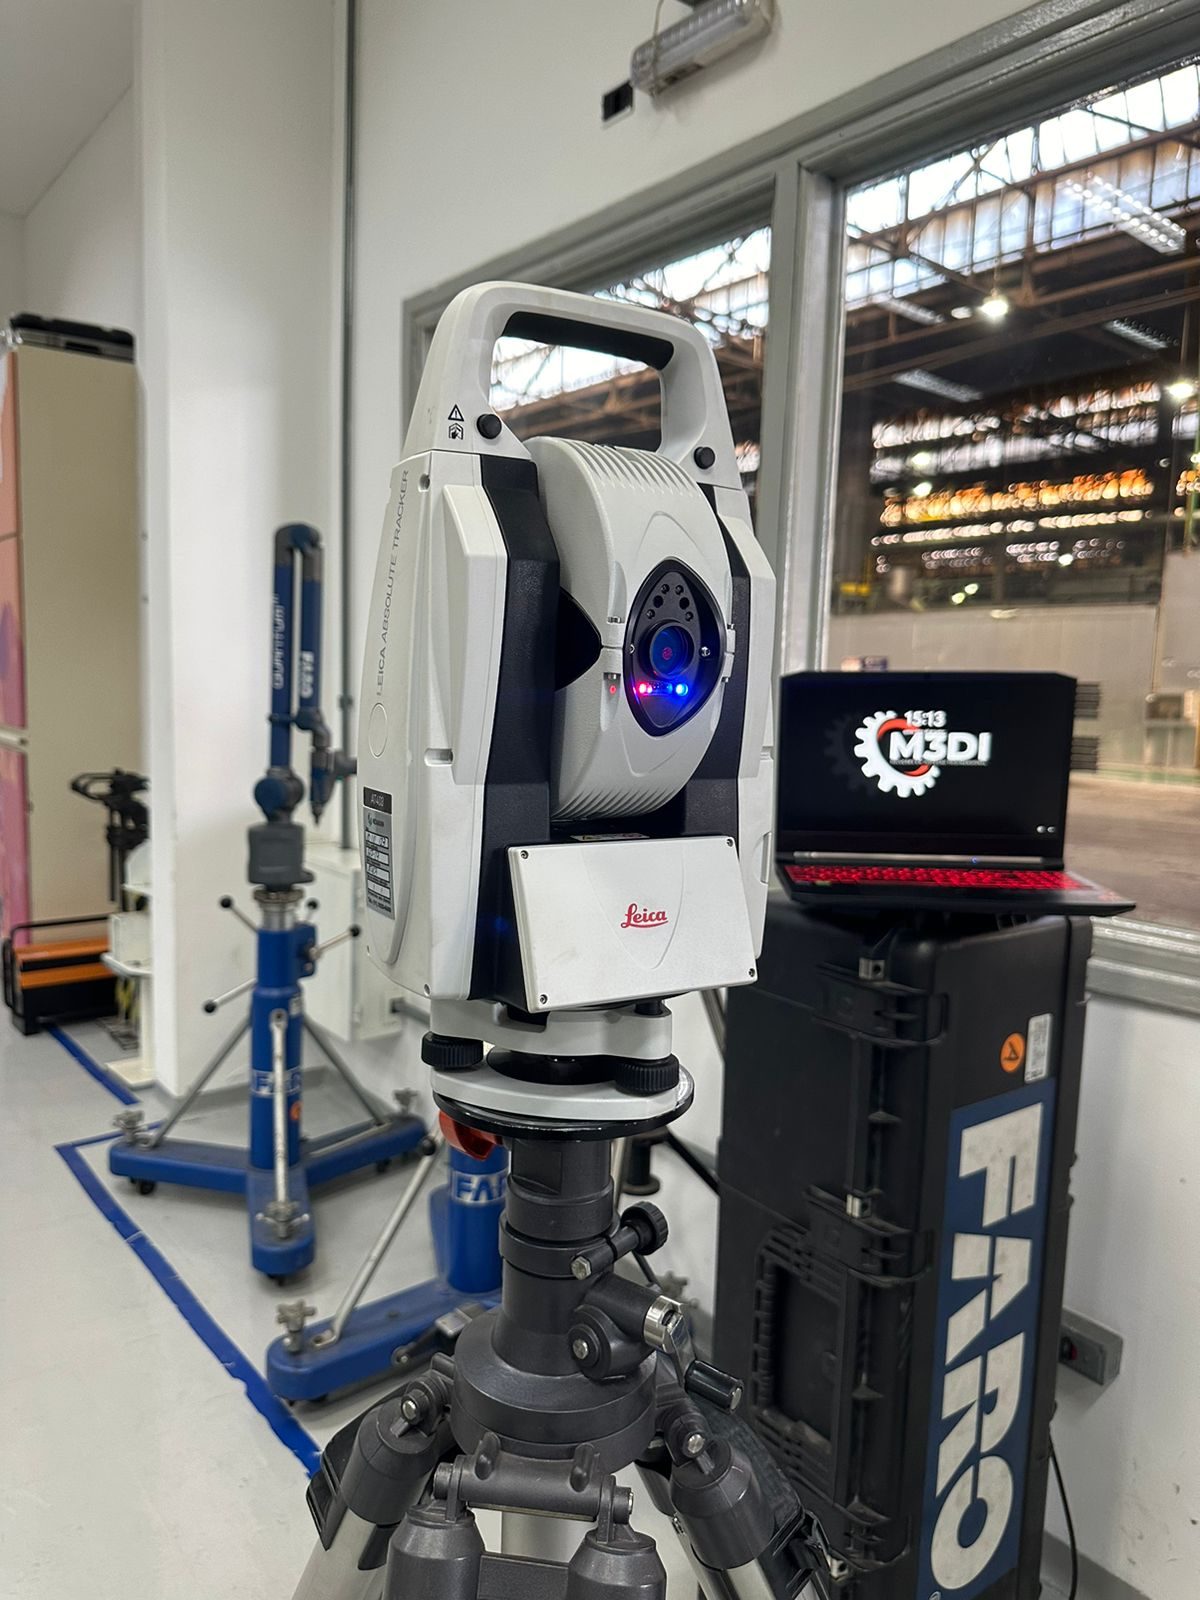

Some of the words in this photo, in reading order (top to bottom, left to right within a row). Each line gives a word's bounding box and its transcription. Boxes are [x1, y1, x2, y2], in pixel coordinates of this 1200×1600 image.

[376, 646, 386, 696] LEICA
[381, 553, 397, 643] ABSOLUTE
[392, 469, 409, 550] TRACKER
[904, 710, 947, 728] 15:13
[889, 730, 992, 762] M3DI
[620, 903, 669, 929] Leica
[931, 1102, 1043, 1591] FARO
